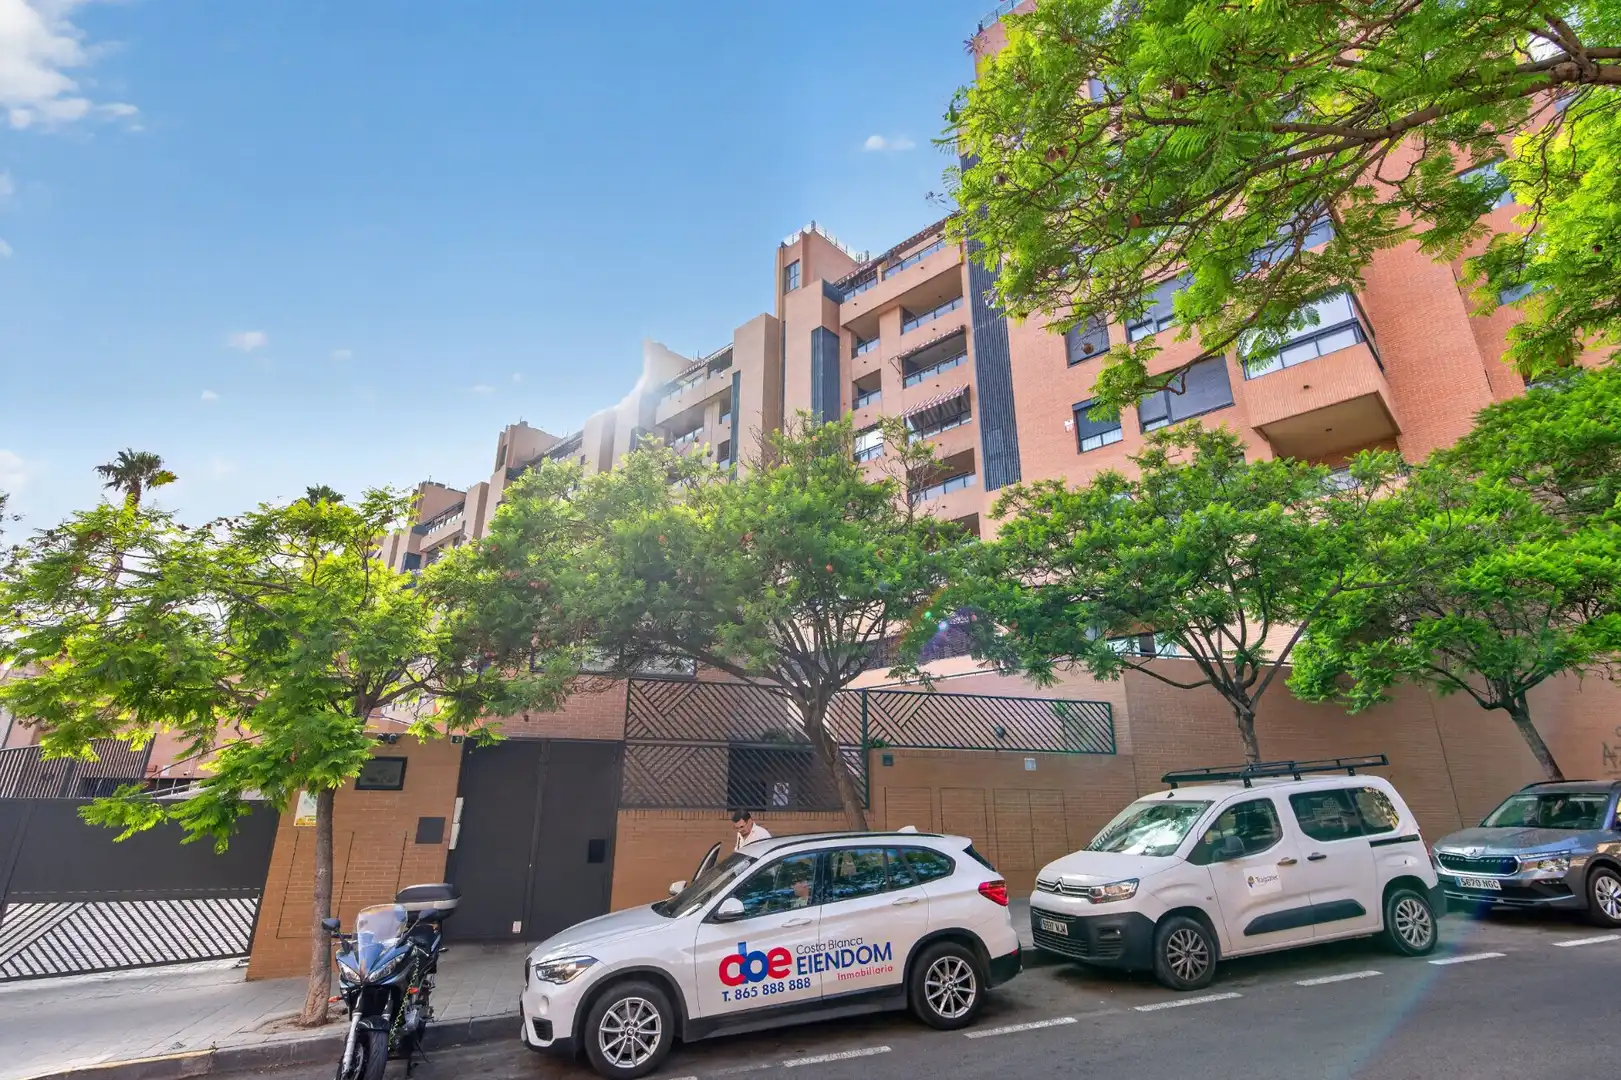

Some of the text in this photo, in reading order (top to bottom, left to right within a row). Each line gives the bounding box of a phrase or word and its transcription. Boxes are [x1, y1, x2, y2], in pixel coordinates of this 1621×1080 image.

[796, 937, 863, 955] Costa Blanca
[796, 941, 893, 976] EIENDOM
[722, 977, 811, 1002] T. 865 888 888
